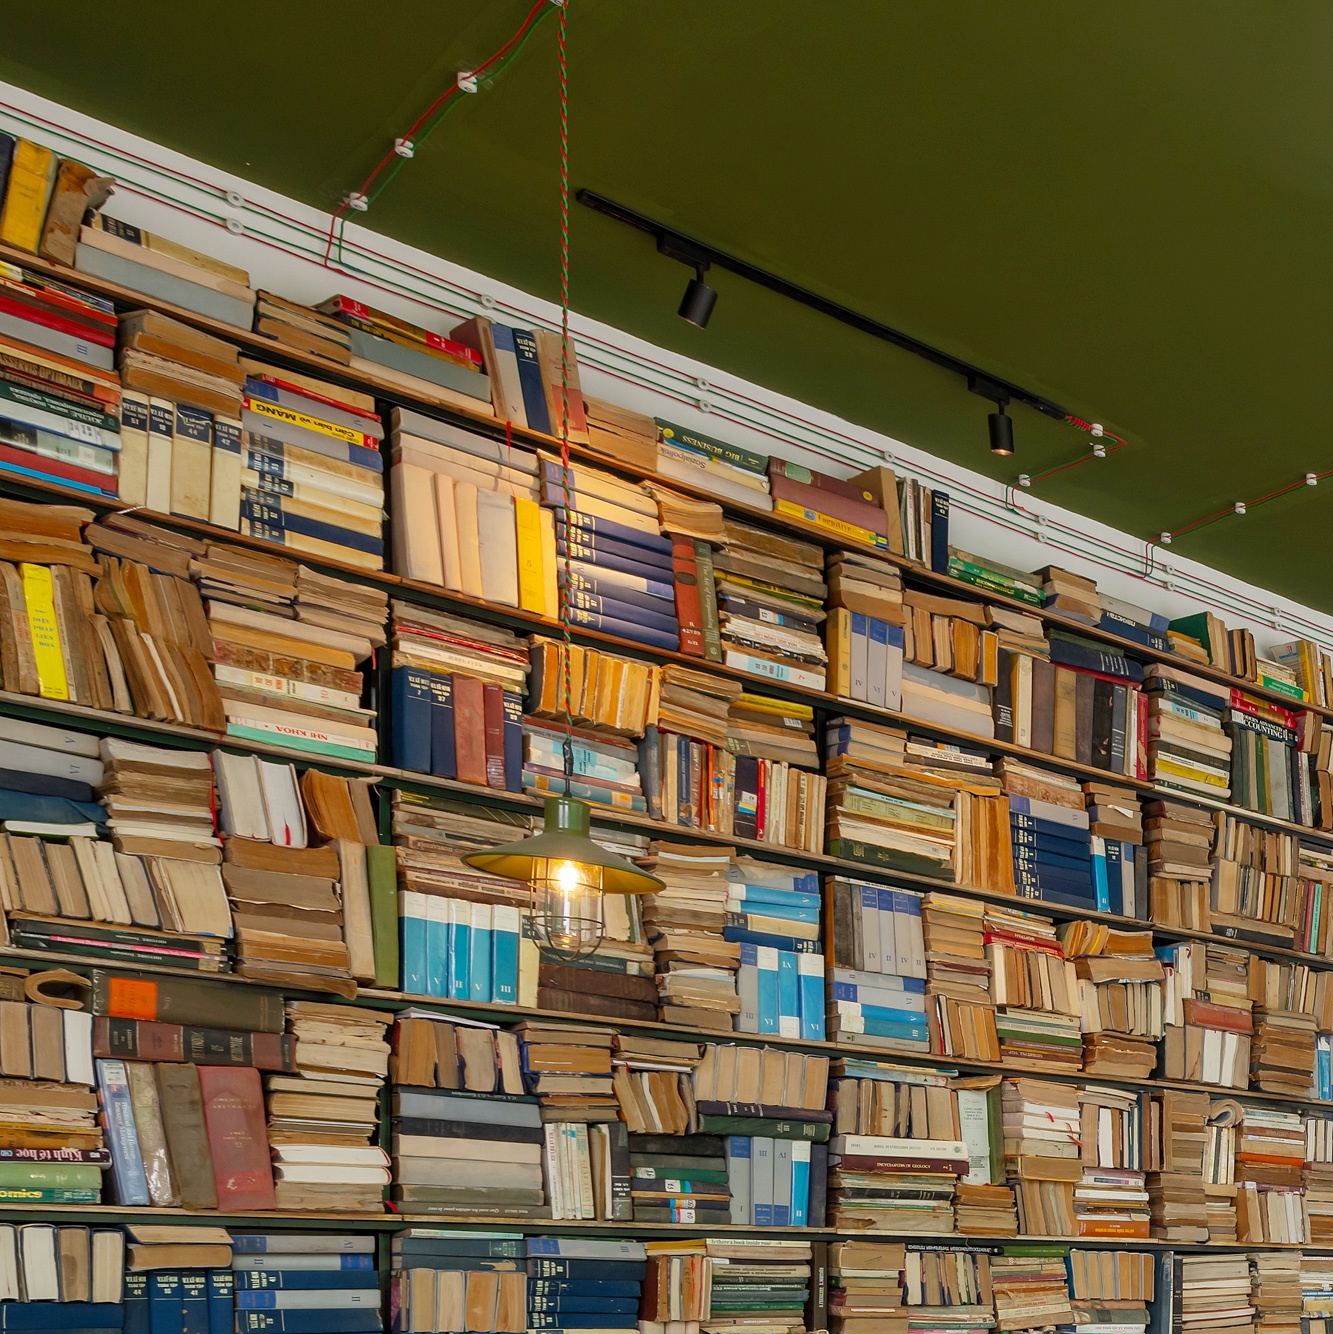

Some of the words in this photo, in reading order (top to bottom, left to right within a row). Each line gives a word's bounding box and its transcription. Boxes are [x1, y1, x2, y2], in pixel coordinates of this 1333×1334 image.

[682, 434, 722, 455] BUSINESS
[659, 446, 706, 469] Sozialpolitik
[818, 513, 852, 532] Cognitive
[275, 725, 307, 737] KHOA
[1242, 718, 1283, 739] CCOUNTING
[1259, 719, 1283, 732] ADVANCED
[500, 985, 511, 993] III
[15, 1148, 38, 1161] học
[39, 1150, 51, 1162] tế
[52, 1148, 83, 1162] Kinh
